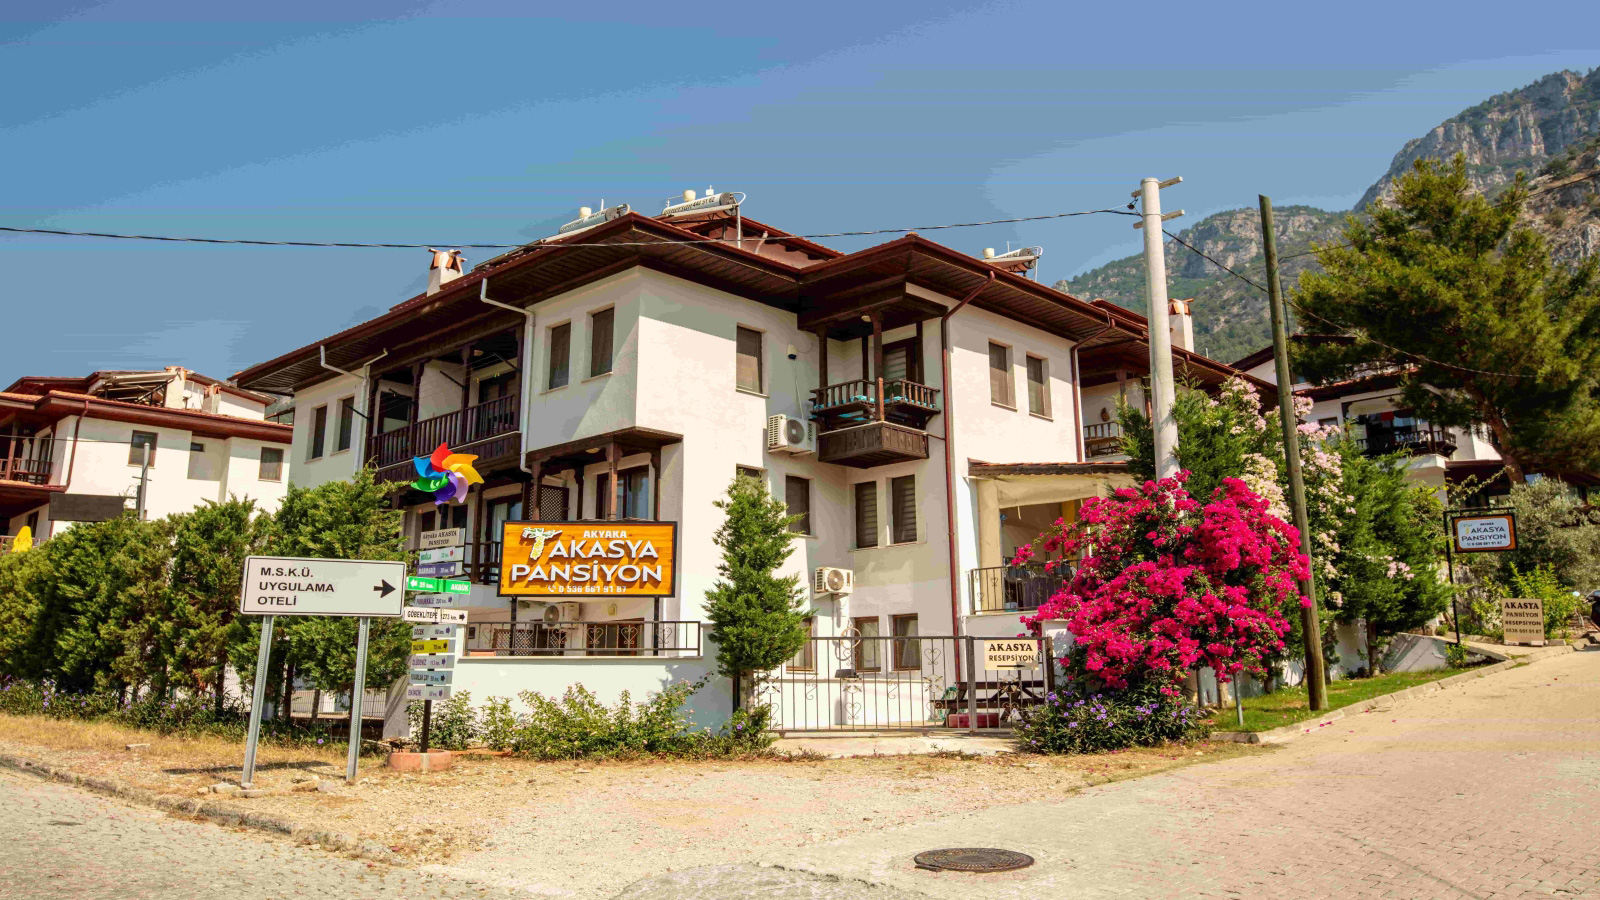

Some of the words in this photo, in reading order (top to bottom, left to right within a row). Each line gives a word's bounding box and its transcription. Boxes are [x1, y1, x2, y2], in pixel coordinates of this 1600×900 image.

[583, 530, 627, 538] AKYAKA
[549, 540, 659, 558] AKASYA
[260, 567, 313, 577] M.S.K.Ü.
[511, 560, 662, 582] PANSİYON
[259, 582, 335, 592] UYGULAMA
[257, 596, 297, 606] OTELİ
[408, 610, 437, 619] GÖBEKLİTEPE
